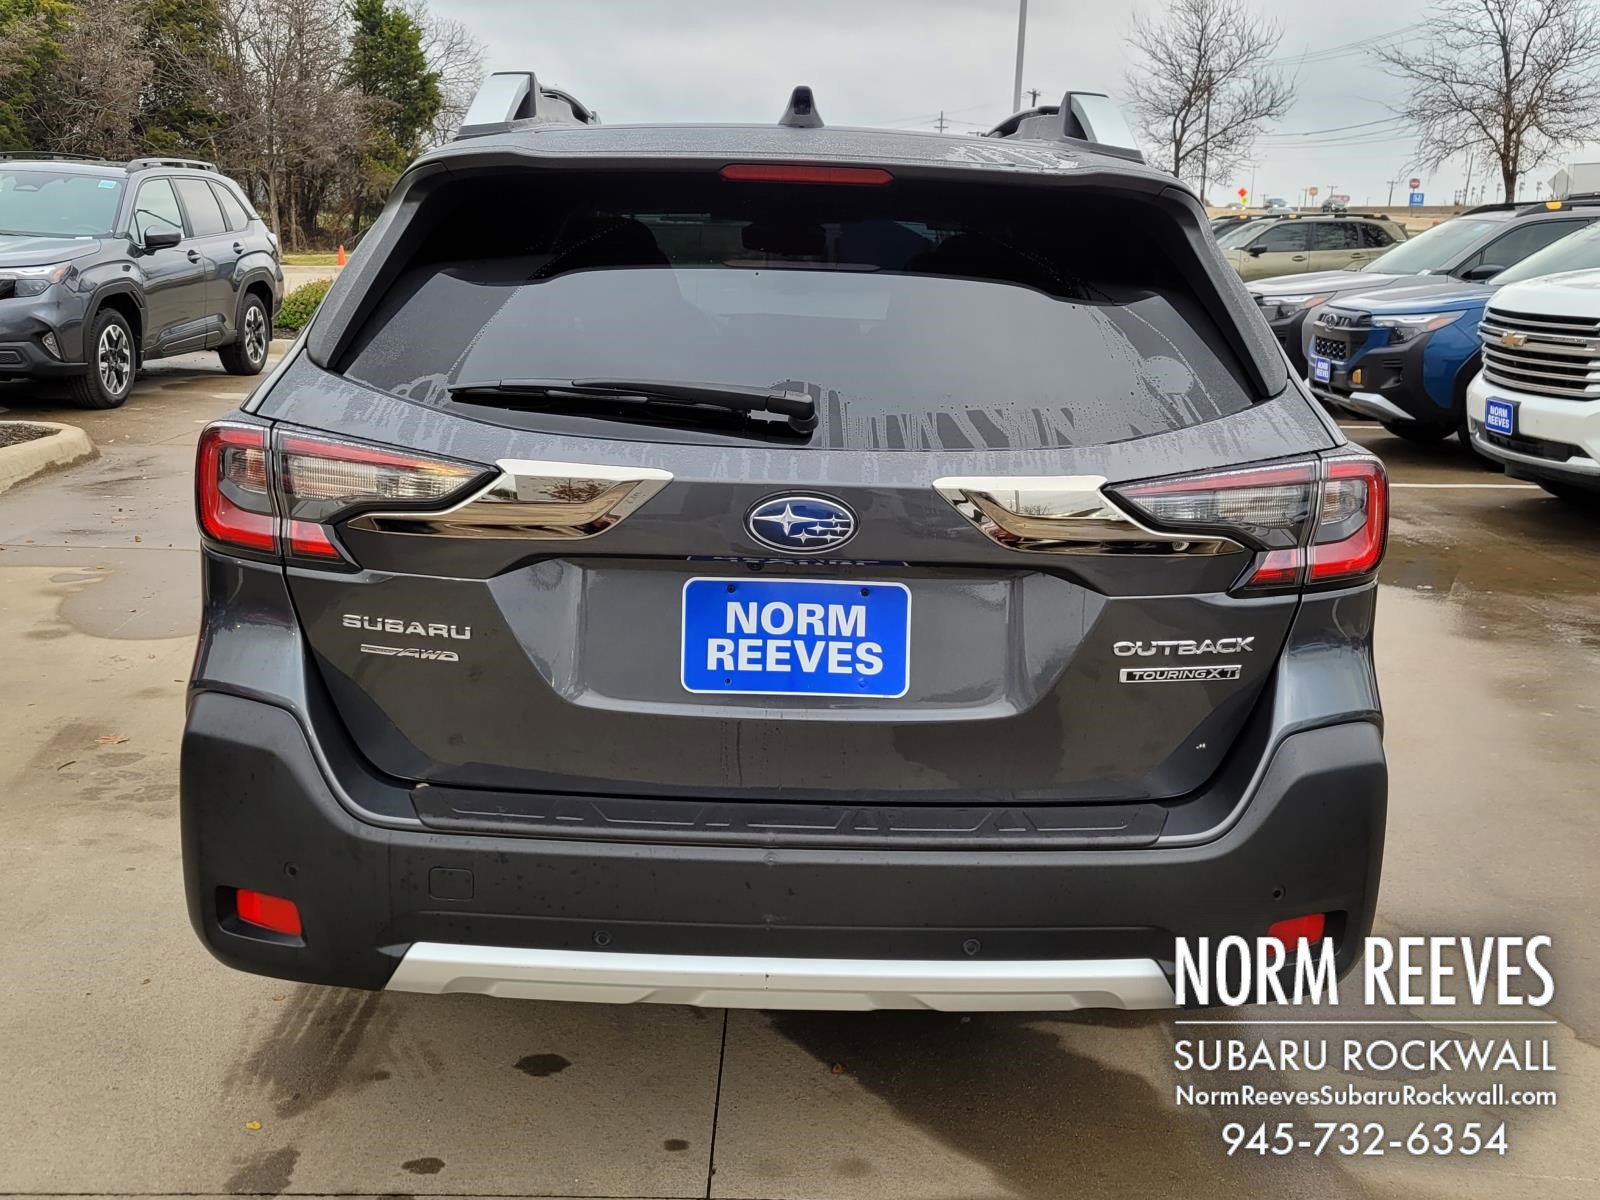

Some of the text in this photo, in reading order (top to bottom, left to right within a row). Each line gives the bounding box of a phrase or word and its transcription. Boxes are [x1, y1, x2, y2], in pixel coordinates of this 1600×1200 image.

[1488, 414, 1510, 429] REEVES
[1490, 405, 1508, 418] NORM
[342, 613, 472, 640] SUBARU
[726, 601, 867, 637] NORM
[397, 647, 459, 662] AWD
[707, 638, 884, 676] REEVES
[1112, 636, 1256, 657] OUTBACK
